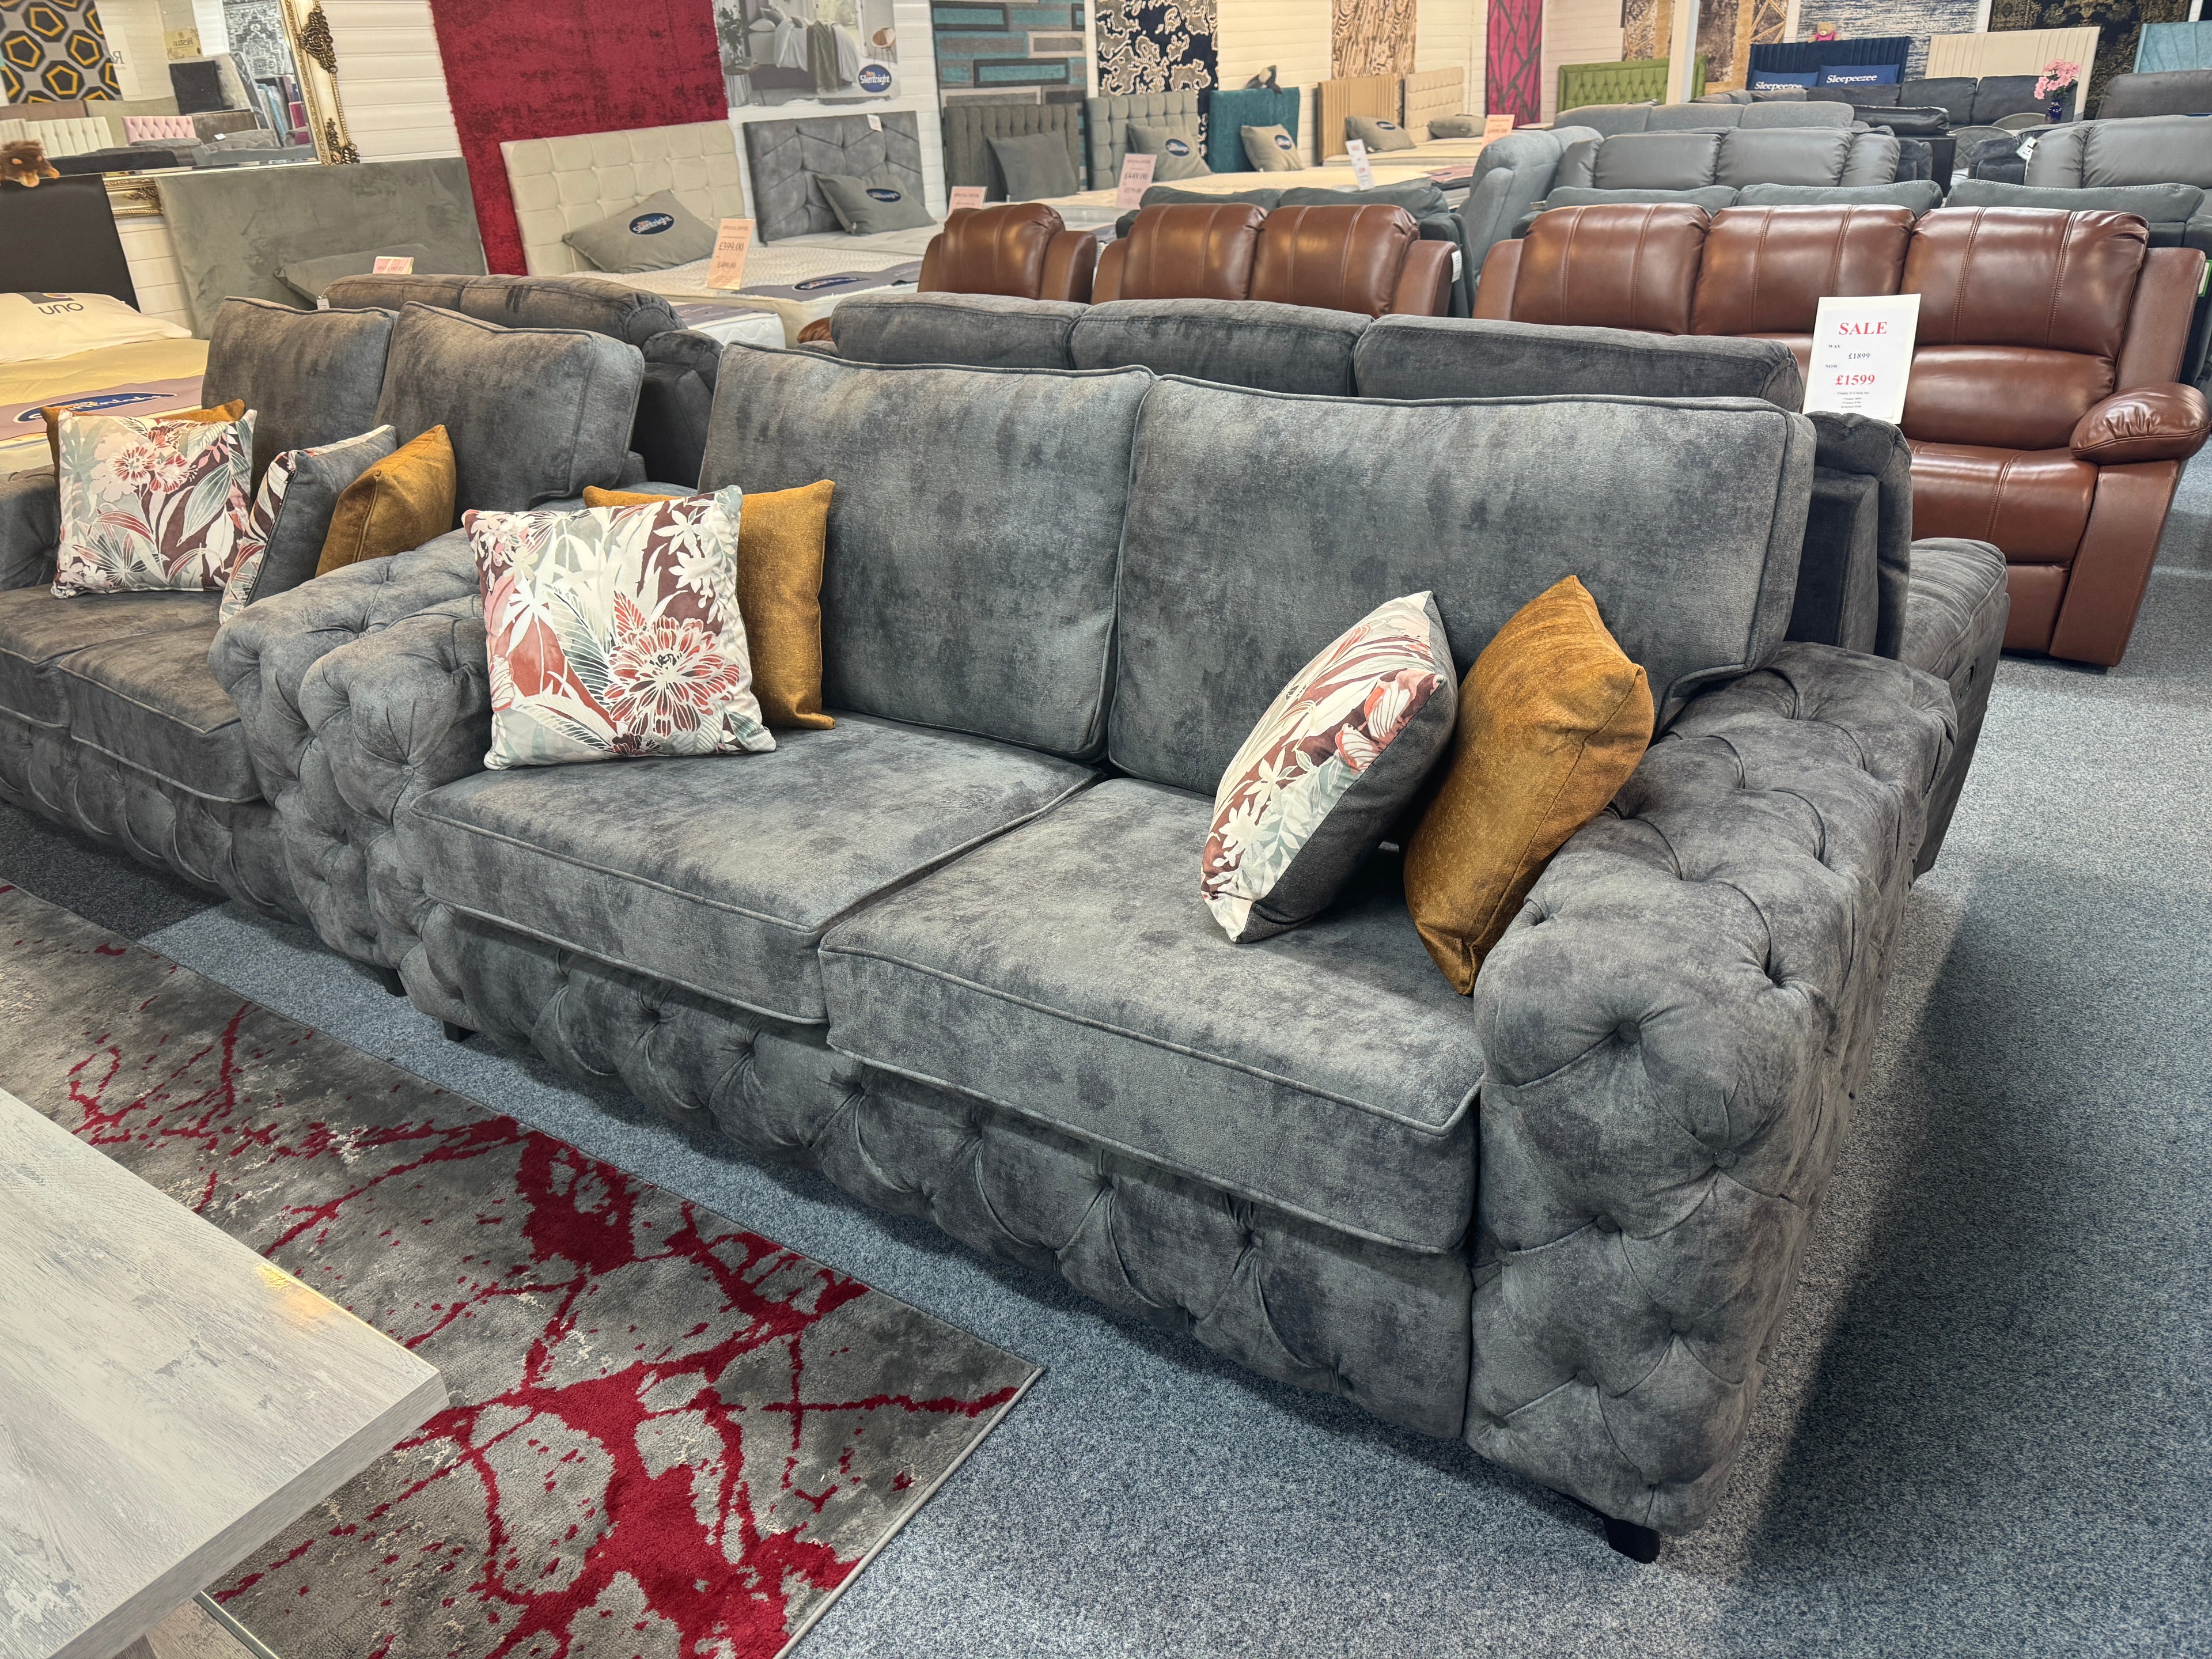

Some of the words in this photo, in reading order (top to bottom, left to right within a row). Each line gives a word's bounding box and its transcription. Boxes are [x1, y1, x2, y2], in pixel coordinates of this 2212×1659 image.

[1826, 74, 1878, 84] Sleepeezee
[1839, 322, 1887, 335] SALE
[1835, 374, 1875, 385] £1599
